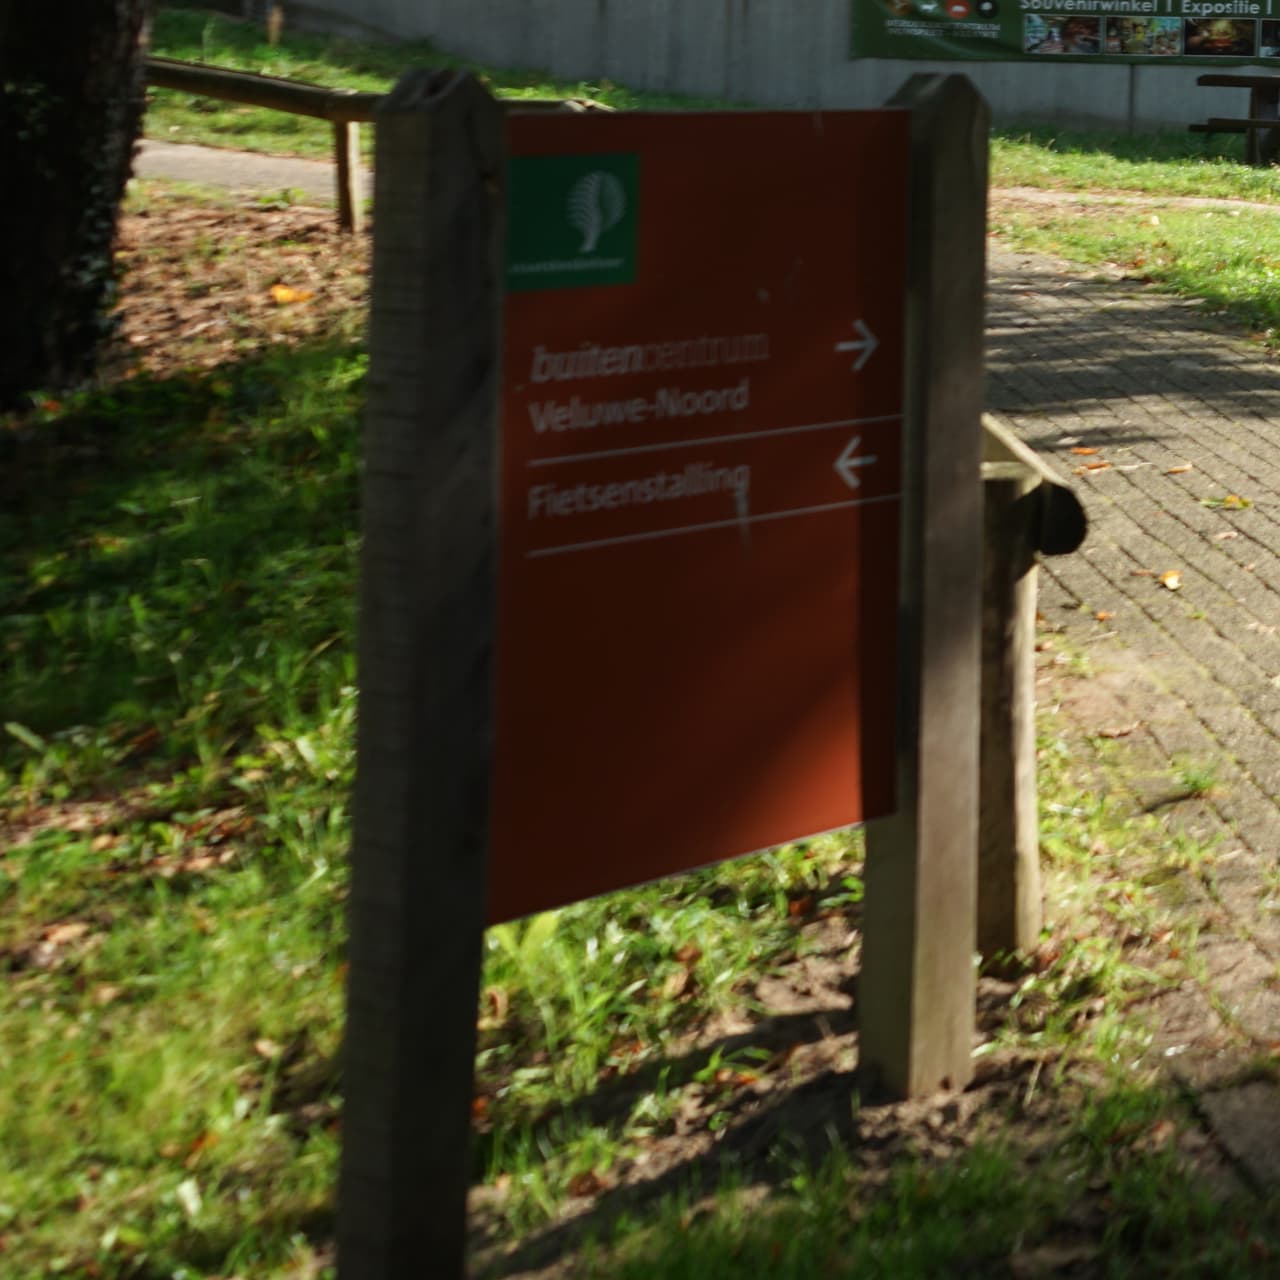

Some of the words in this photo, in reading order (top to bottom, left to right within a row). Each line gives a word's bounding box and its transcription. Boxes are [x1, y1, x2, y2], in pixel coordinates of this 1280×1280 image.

[531, 333, 769, 382] buitencentrum
[529, 377, 750, 433] Veluwe-Noord
[527, 462, 751, 519] Fietsenstalling
